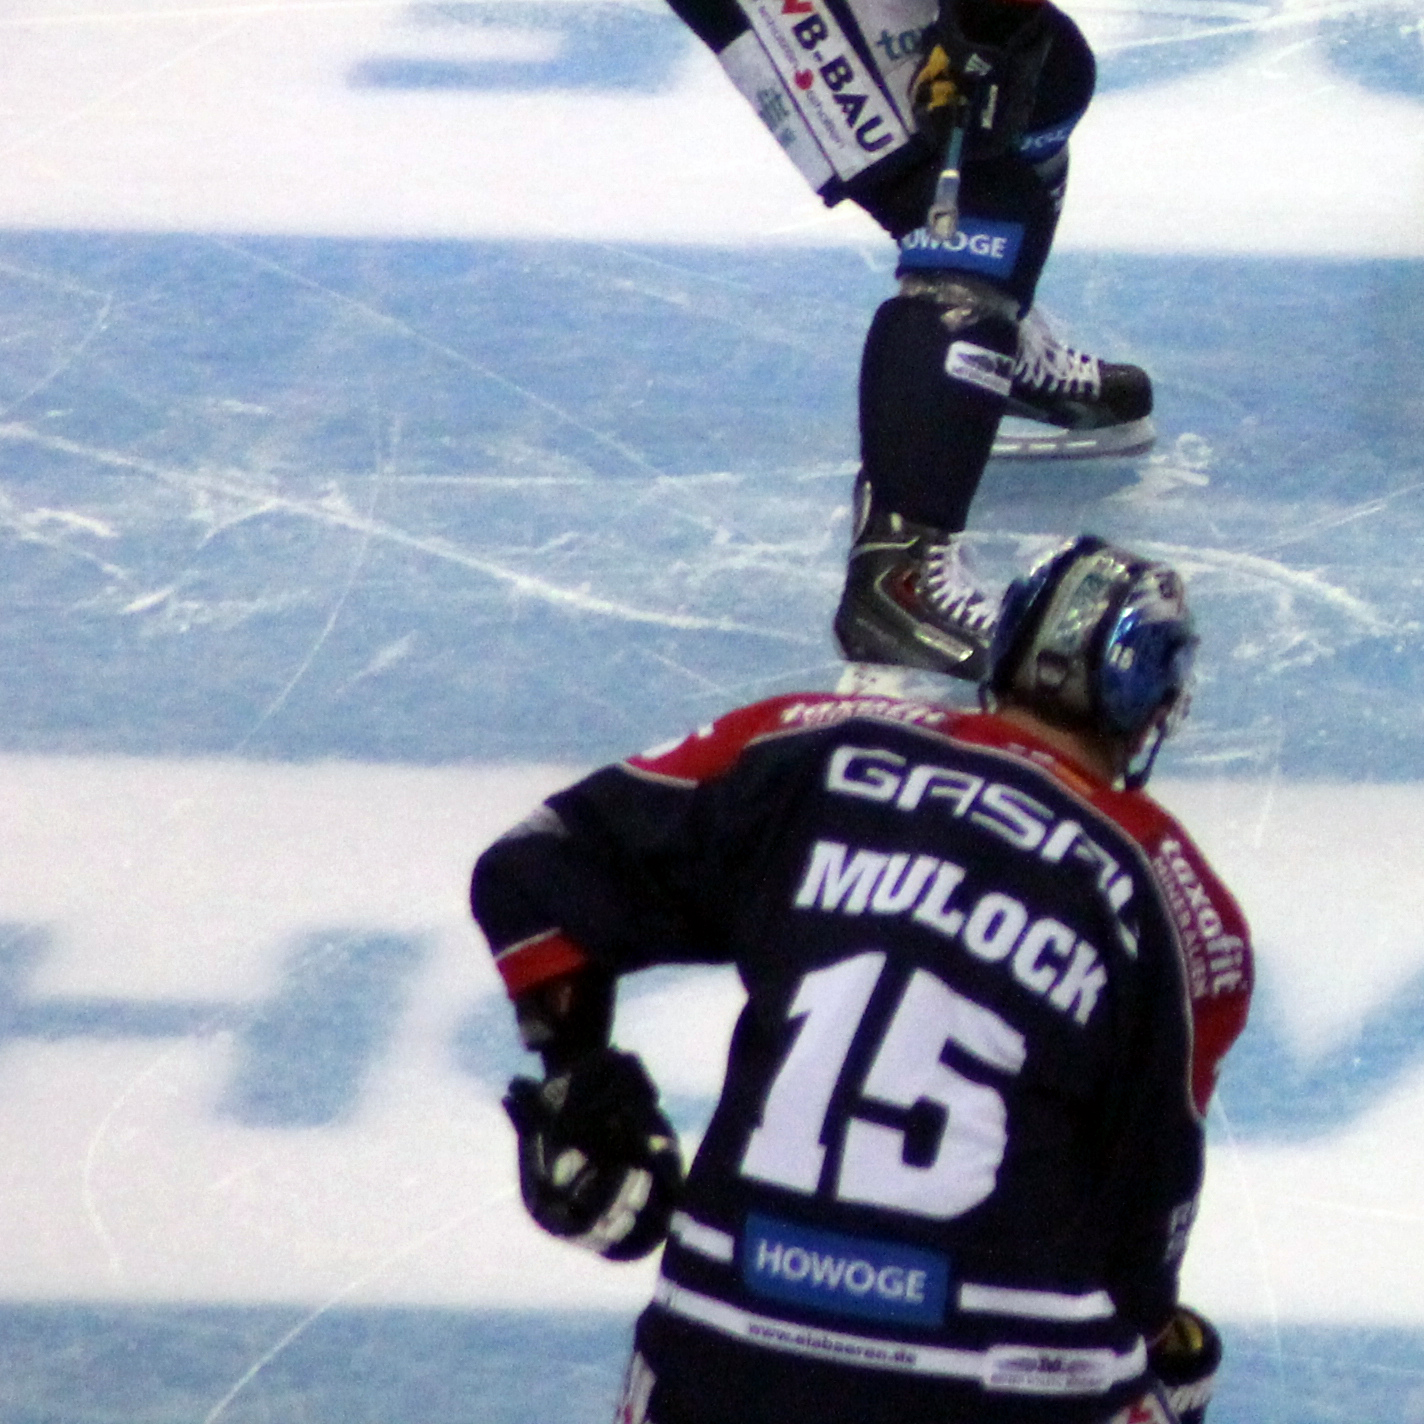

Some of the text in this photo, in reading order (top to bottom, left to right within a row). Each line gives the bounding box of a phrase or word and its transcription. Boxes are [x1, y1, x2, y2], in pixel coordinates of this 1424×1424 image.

[795, 839, 1109, 1026] MULOCK
[738, 950, 1008, 1222] 15
[756, 1237, 928, 1305] HOWOGE
